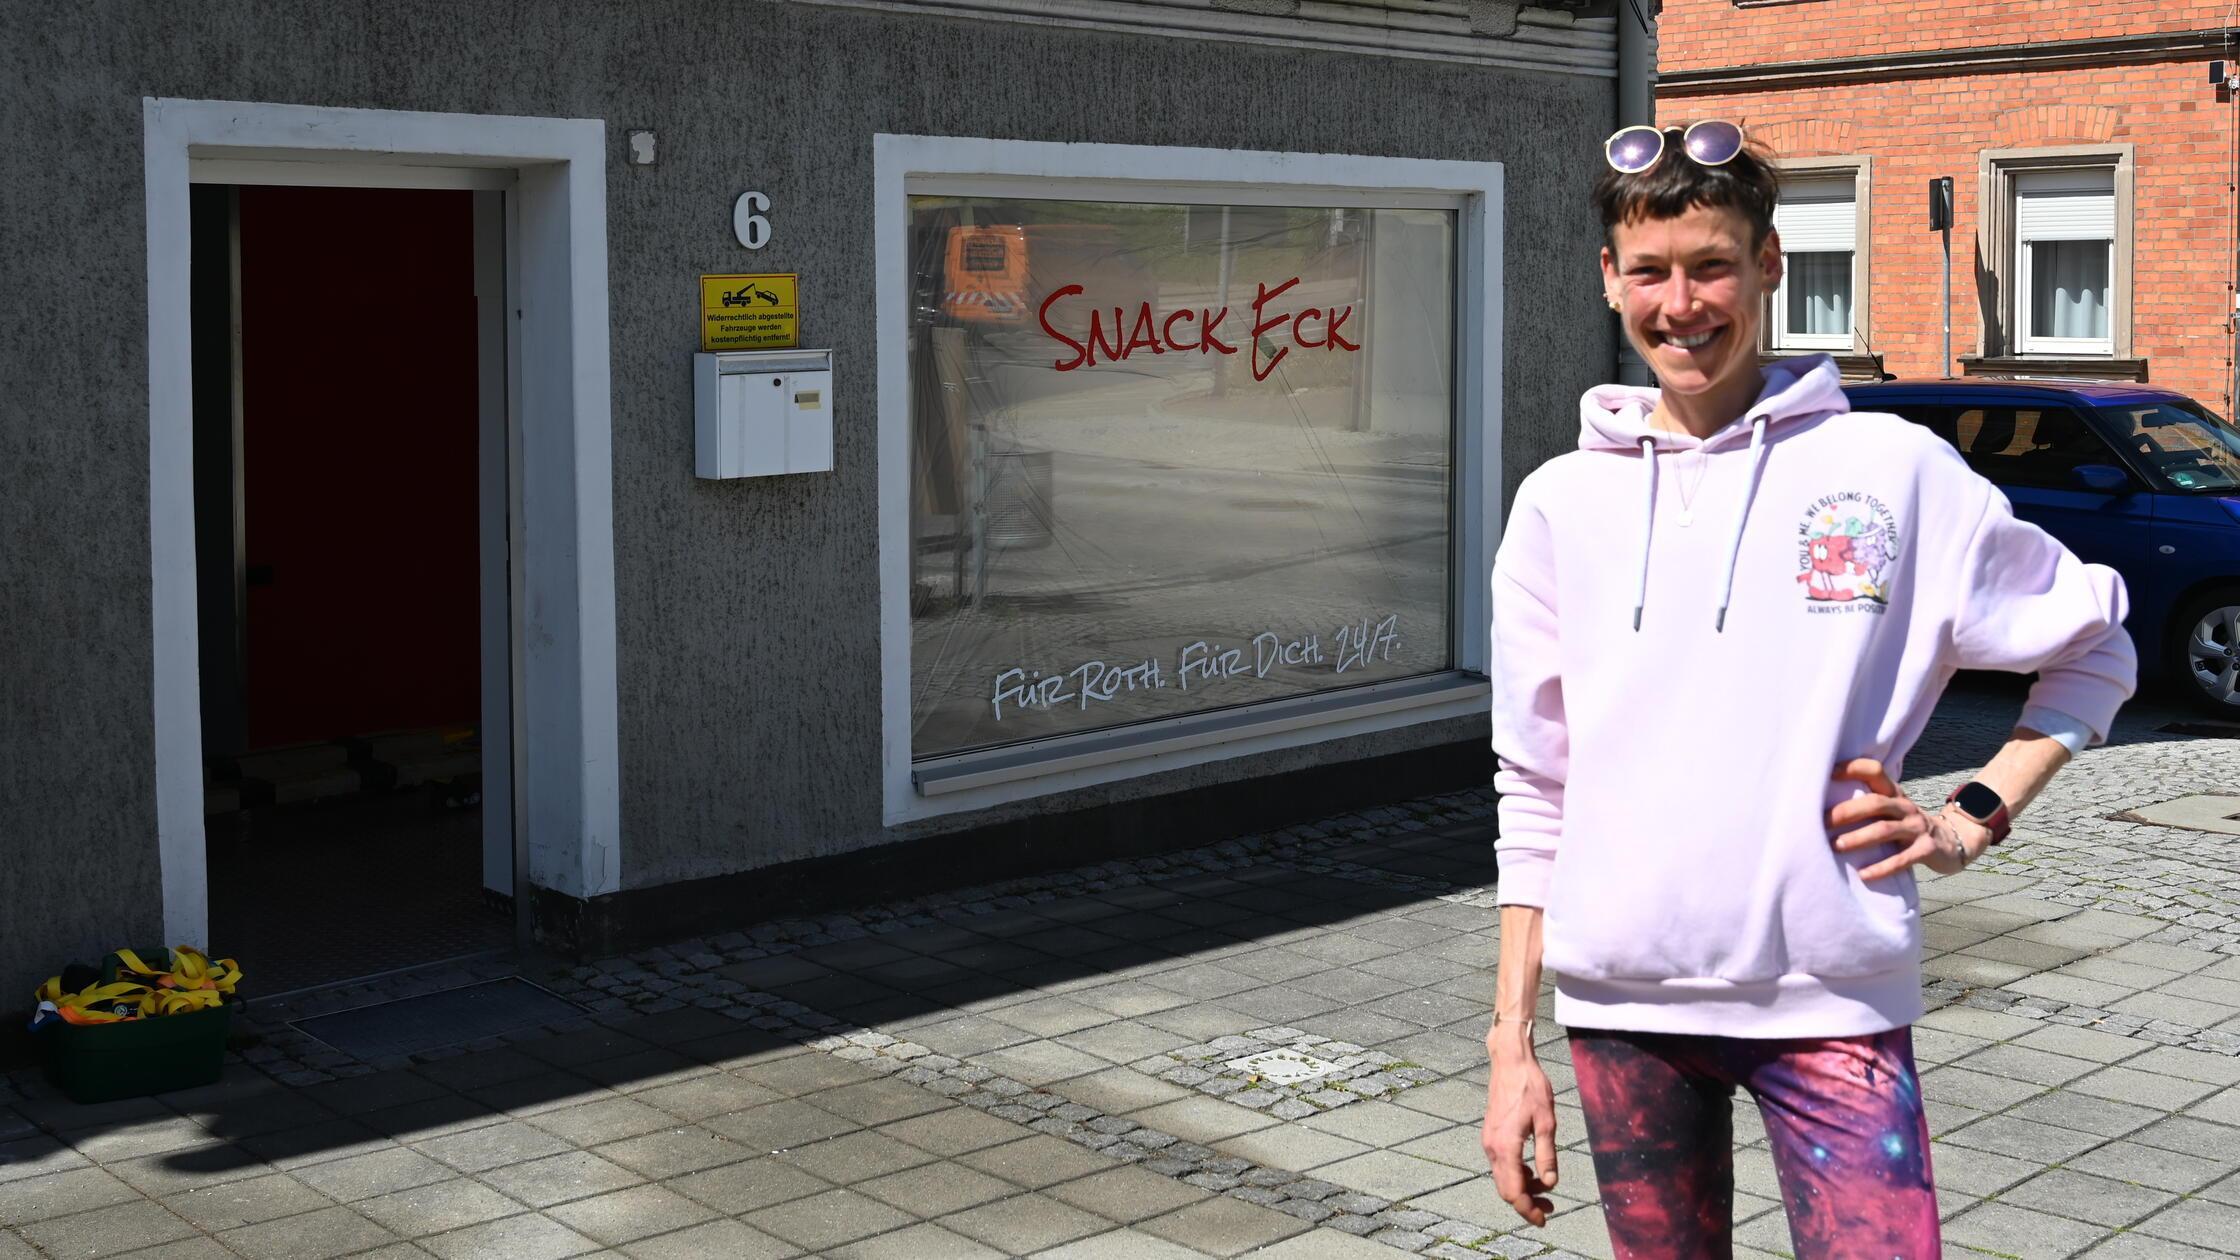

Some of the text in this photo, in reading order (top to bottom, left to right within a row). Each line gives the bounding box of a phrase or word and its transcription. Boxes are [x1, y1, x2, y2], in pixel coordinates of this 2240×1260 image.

[733, 191, 772, 250] 6
[706, 312, 794, 322] Widerrechtlich abgestellte
[720, 323, 782, 333] Fahrzeuge werden
[1038, 277, 1361, 382] SNACK ECK
[711, 332, 791, 344] kostenpflichtig entfernt!
[1818, 492, 1861, 508] BELONG
[1804, 503, 1820, 518] WE
[1799, 551, 1811, 572] YOU
[1069, 658, 1166, 711] ROTH.
[1252, 631, 1324, 678] DICH.
